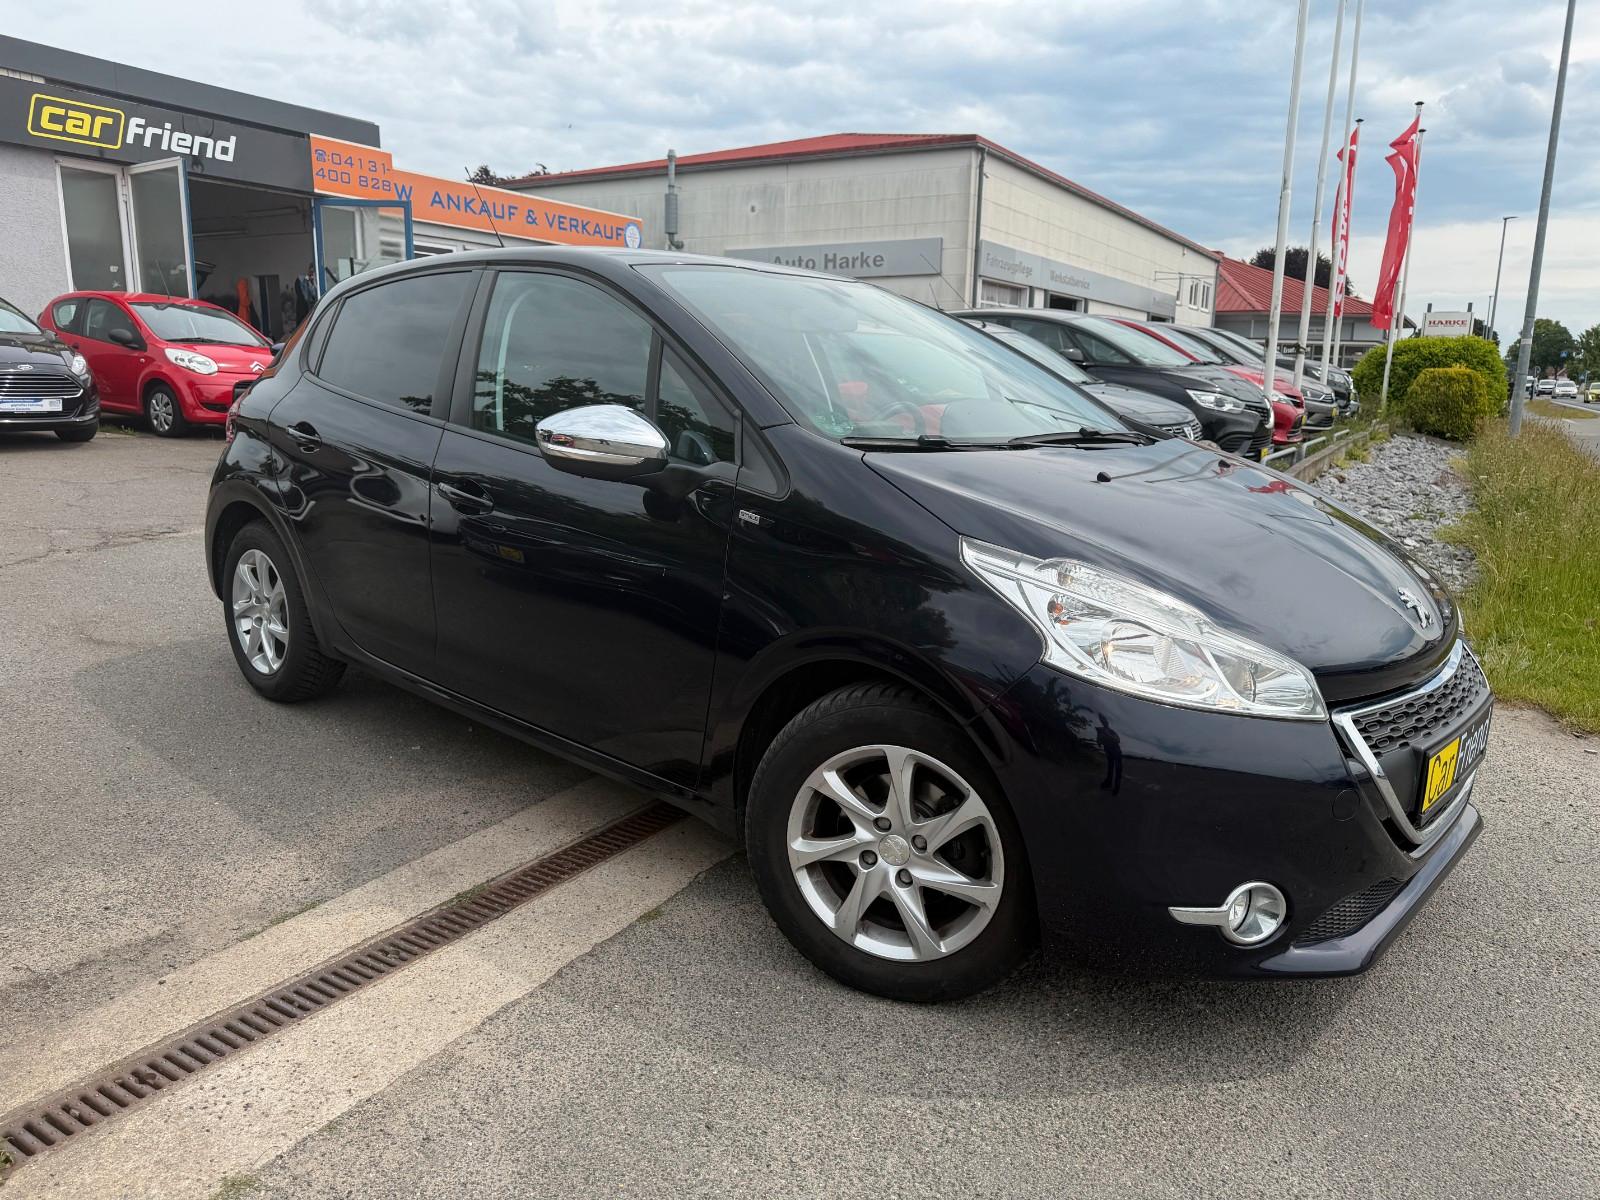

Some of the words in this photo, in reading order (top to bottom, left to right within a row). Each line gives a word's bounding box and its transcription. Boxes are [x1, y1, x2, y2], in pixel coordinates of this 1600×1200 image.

[40, 105, 113, 139] car
[315, 167, 351, 184] 400
[359, 175, 392, 192] 828
[430, 191, 519, 221] ANKAUF
[525, 209, 539, 226] &
[544, 212, 625, 241] VERKAUF
[823, 251, 885, 270] Harke
[1428, 754, 1455, 804] Car
